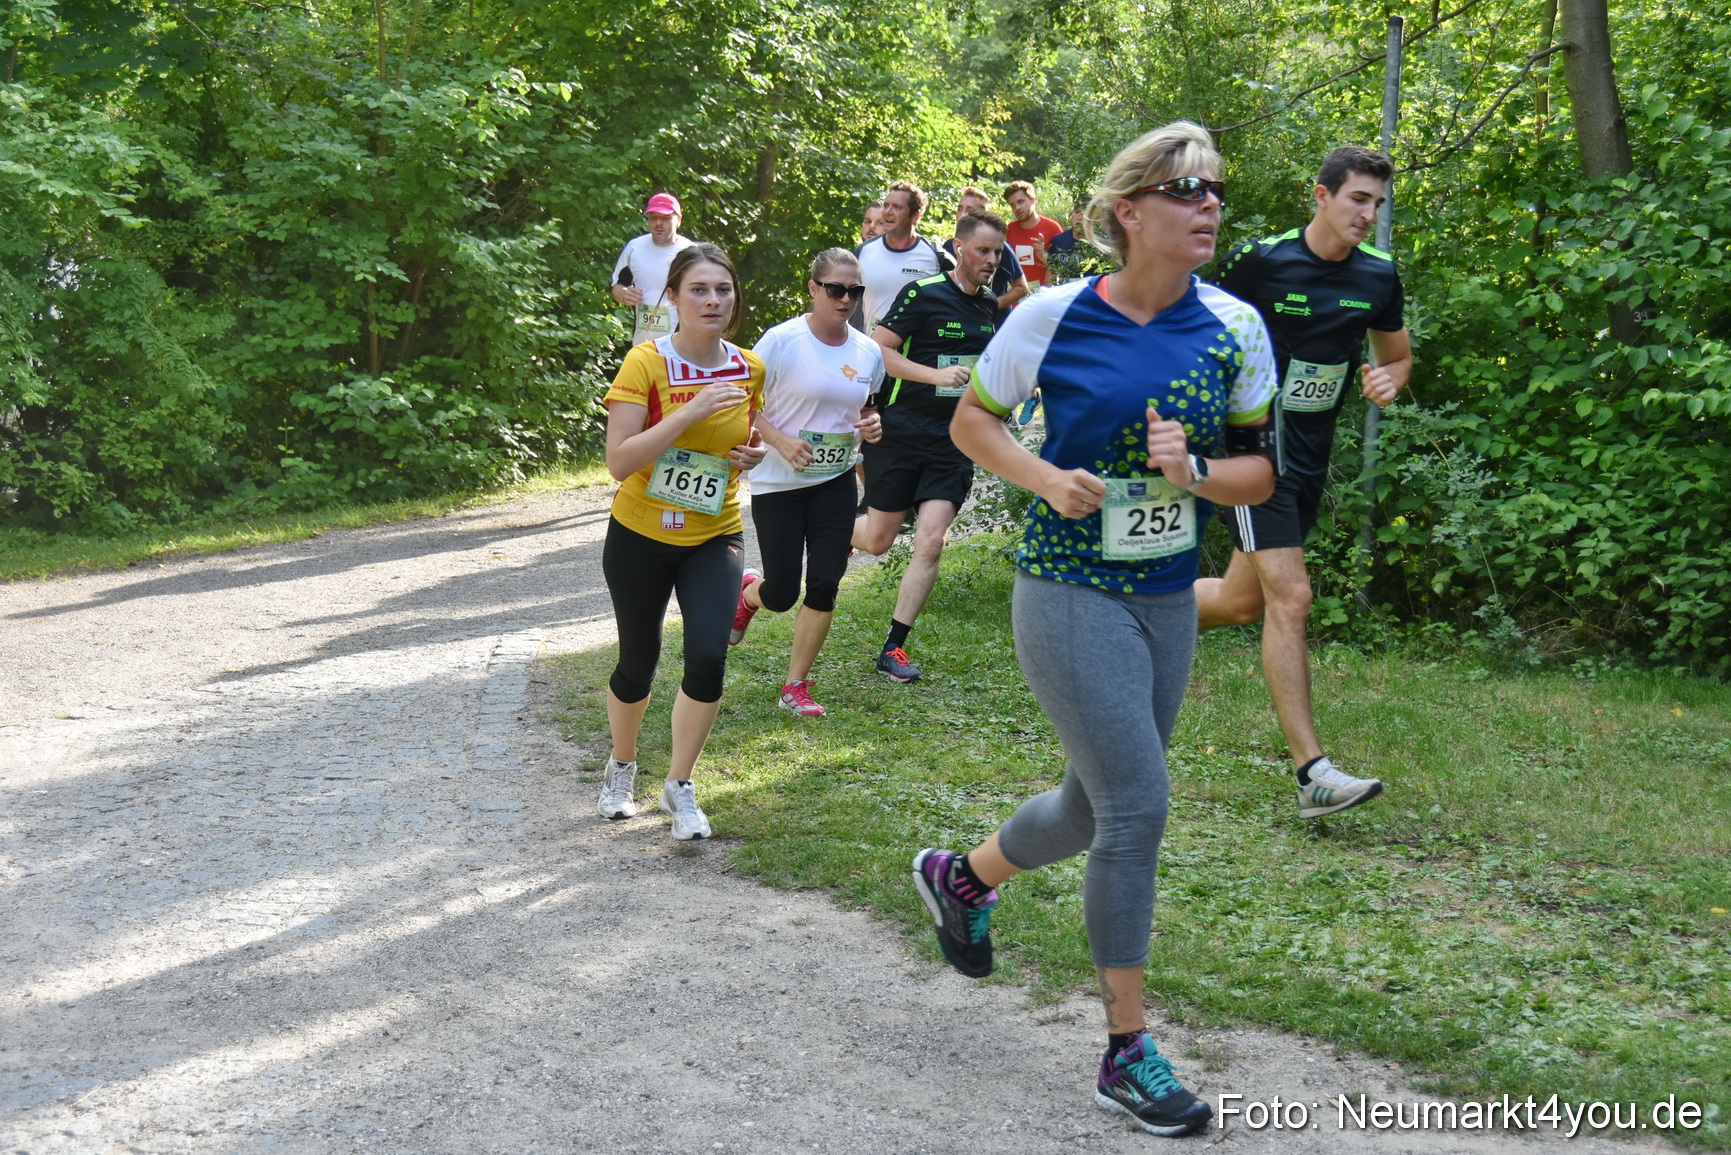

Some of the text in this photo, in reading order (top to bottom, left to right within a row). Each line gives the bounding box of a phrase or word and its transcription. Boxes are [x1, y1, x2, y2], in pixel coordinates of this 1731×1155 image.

[1285, 293, 1307, 303] JAKO
[1339, 299, 1372, 310] DOMINIK
[946, 321, 961, 329] JAKO
[1289, 379, 1337, 399] 2099
[669, 391, 700, 404] MA
[815, 447, 846, 464] 352
[663, 467, 719, 498] 1615
[670, 488, 703, 503] Koller Katja
[1127, 502, 1182, 537] 252
